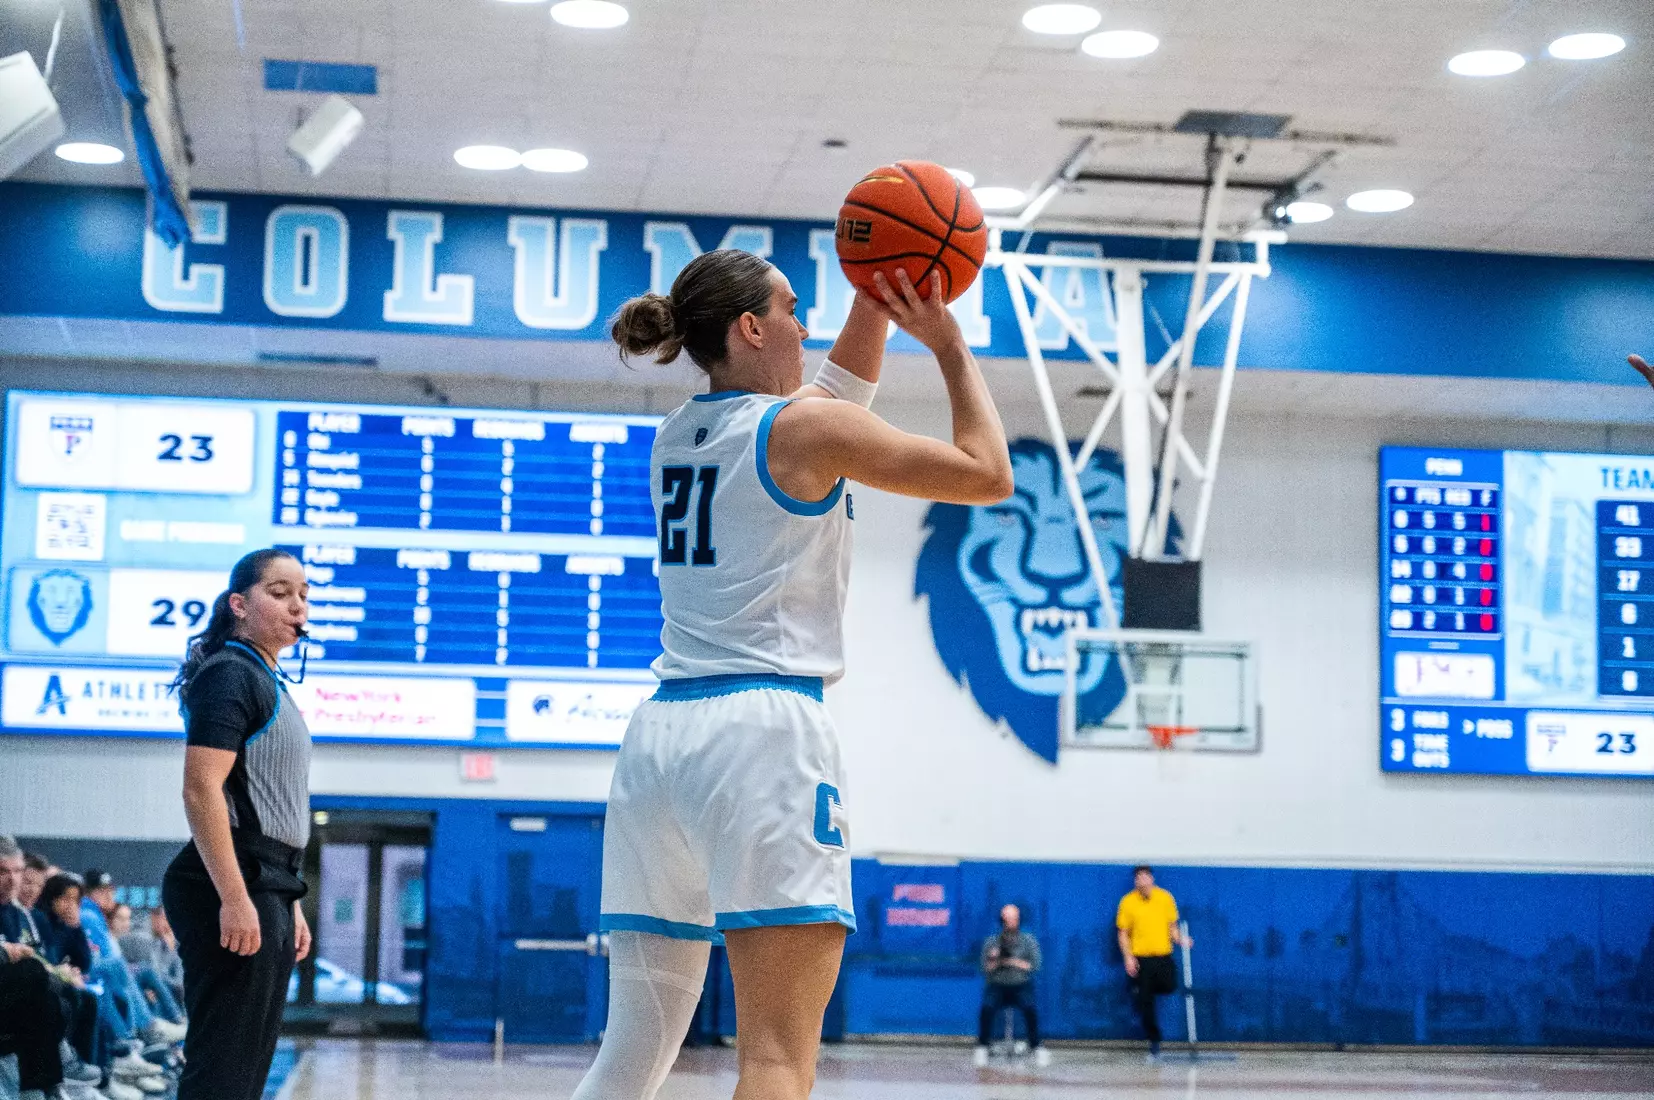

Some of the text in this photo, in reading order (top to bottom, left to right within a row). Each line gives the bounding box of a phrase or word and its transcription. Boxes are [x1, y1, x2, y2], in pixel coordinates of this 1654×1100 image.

[158, 434, 214, 462] 23
[660, 464, 721, 567] 21
[151, 598, 206, 626] 29
[1596, 733, 1636, 753] 23
[813, 781, 847, 850] C
